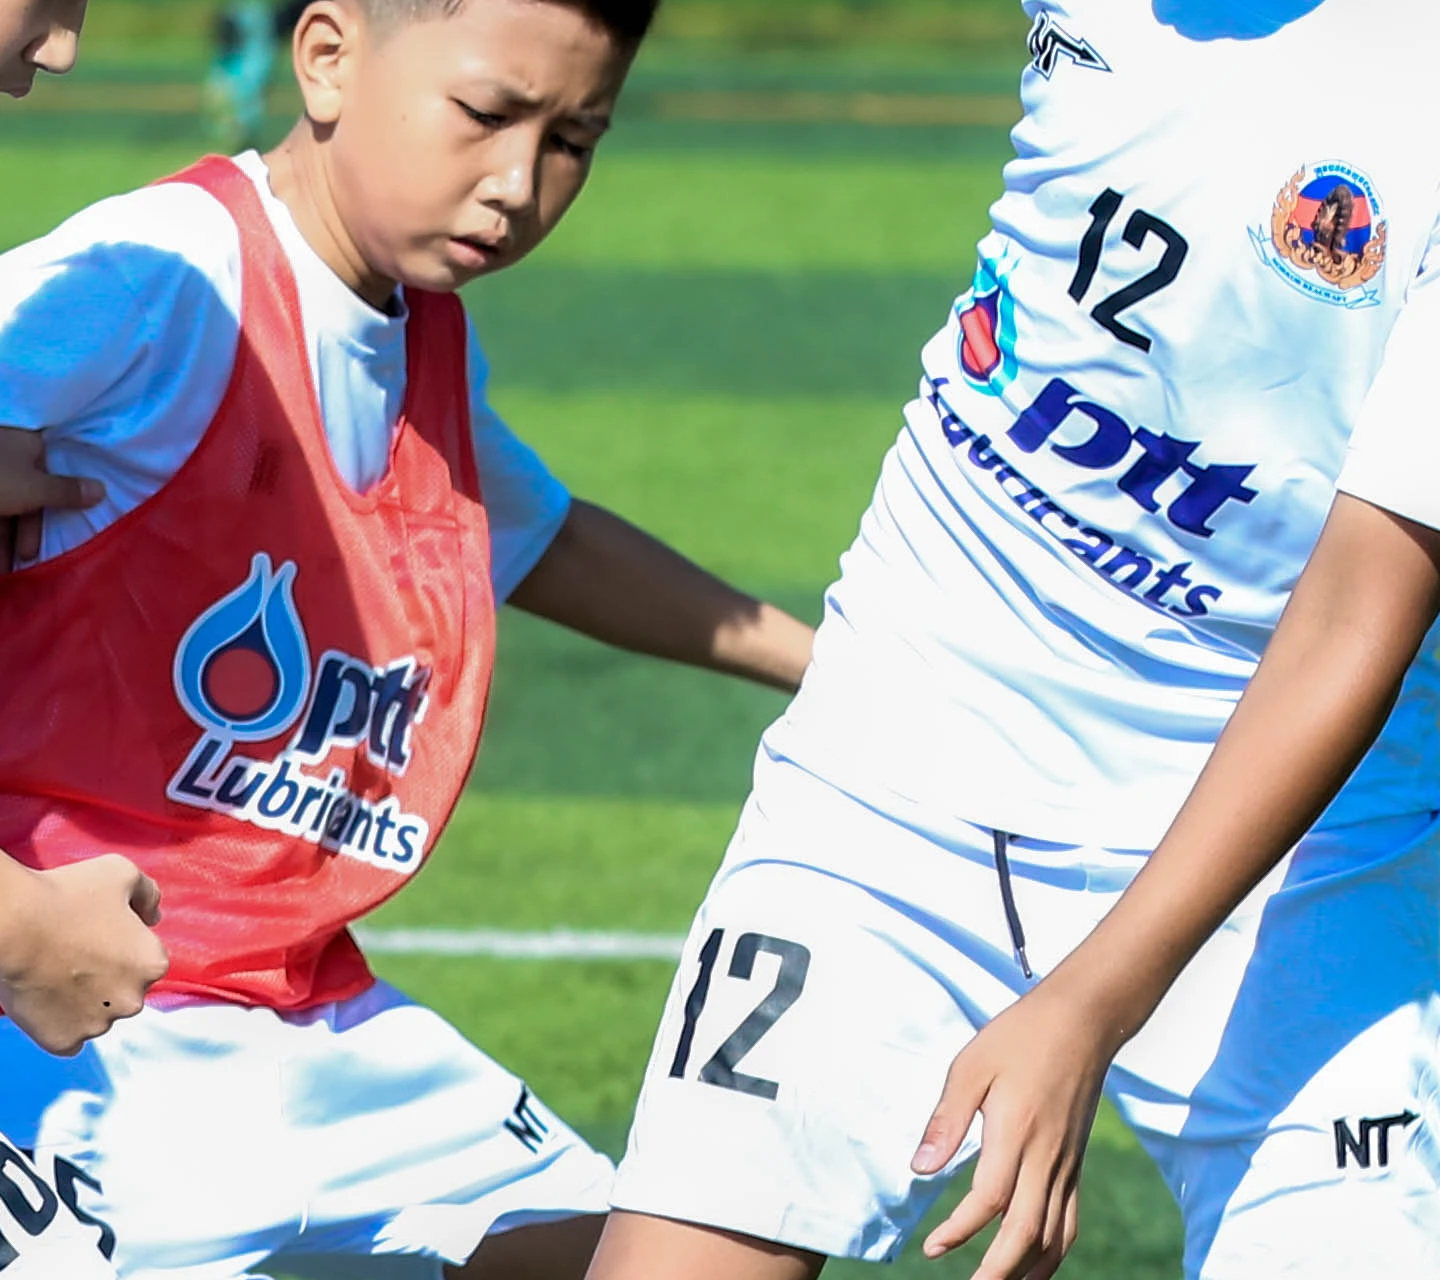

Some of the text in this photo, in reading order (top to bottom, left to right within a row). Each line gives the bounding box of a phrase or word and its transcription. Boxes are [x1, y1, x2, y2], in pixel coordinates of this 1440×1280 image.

[1067, 187, 1189, 354] 12
[1006, 377, 1260, 539] ptt
[668, 927, 812, 1101] 12
[1332, 1108, 1421, 1169] NT
